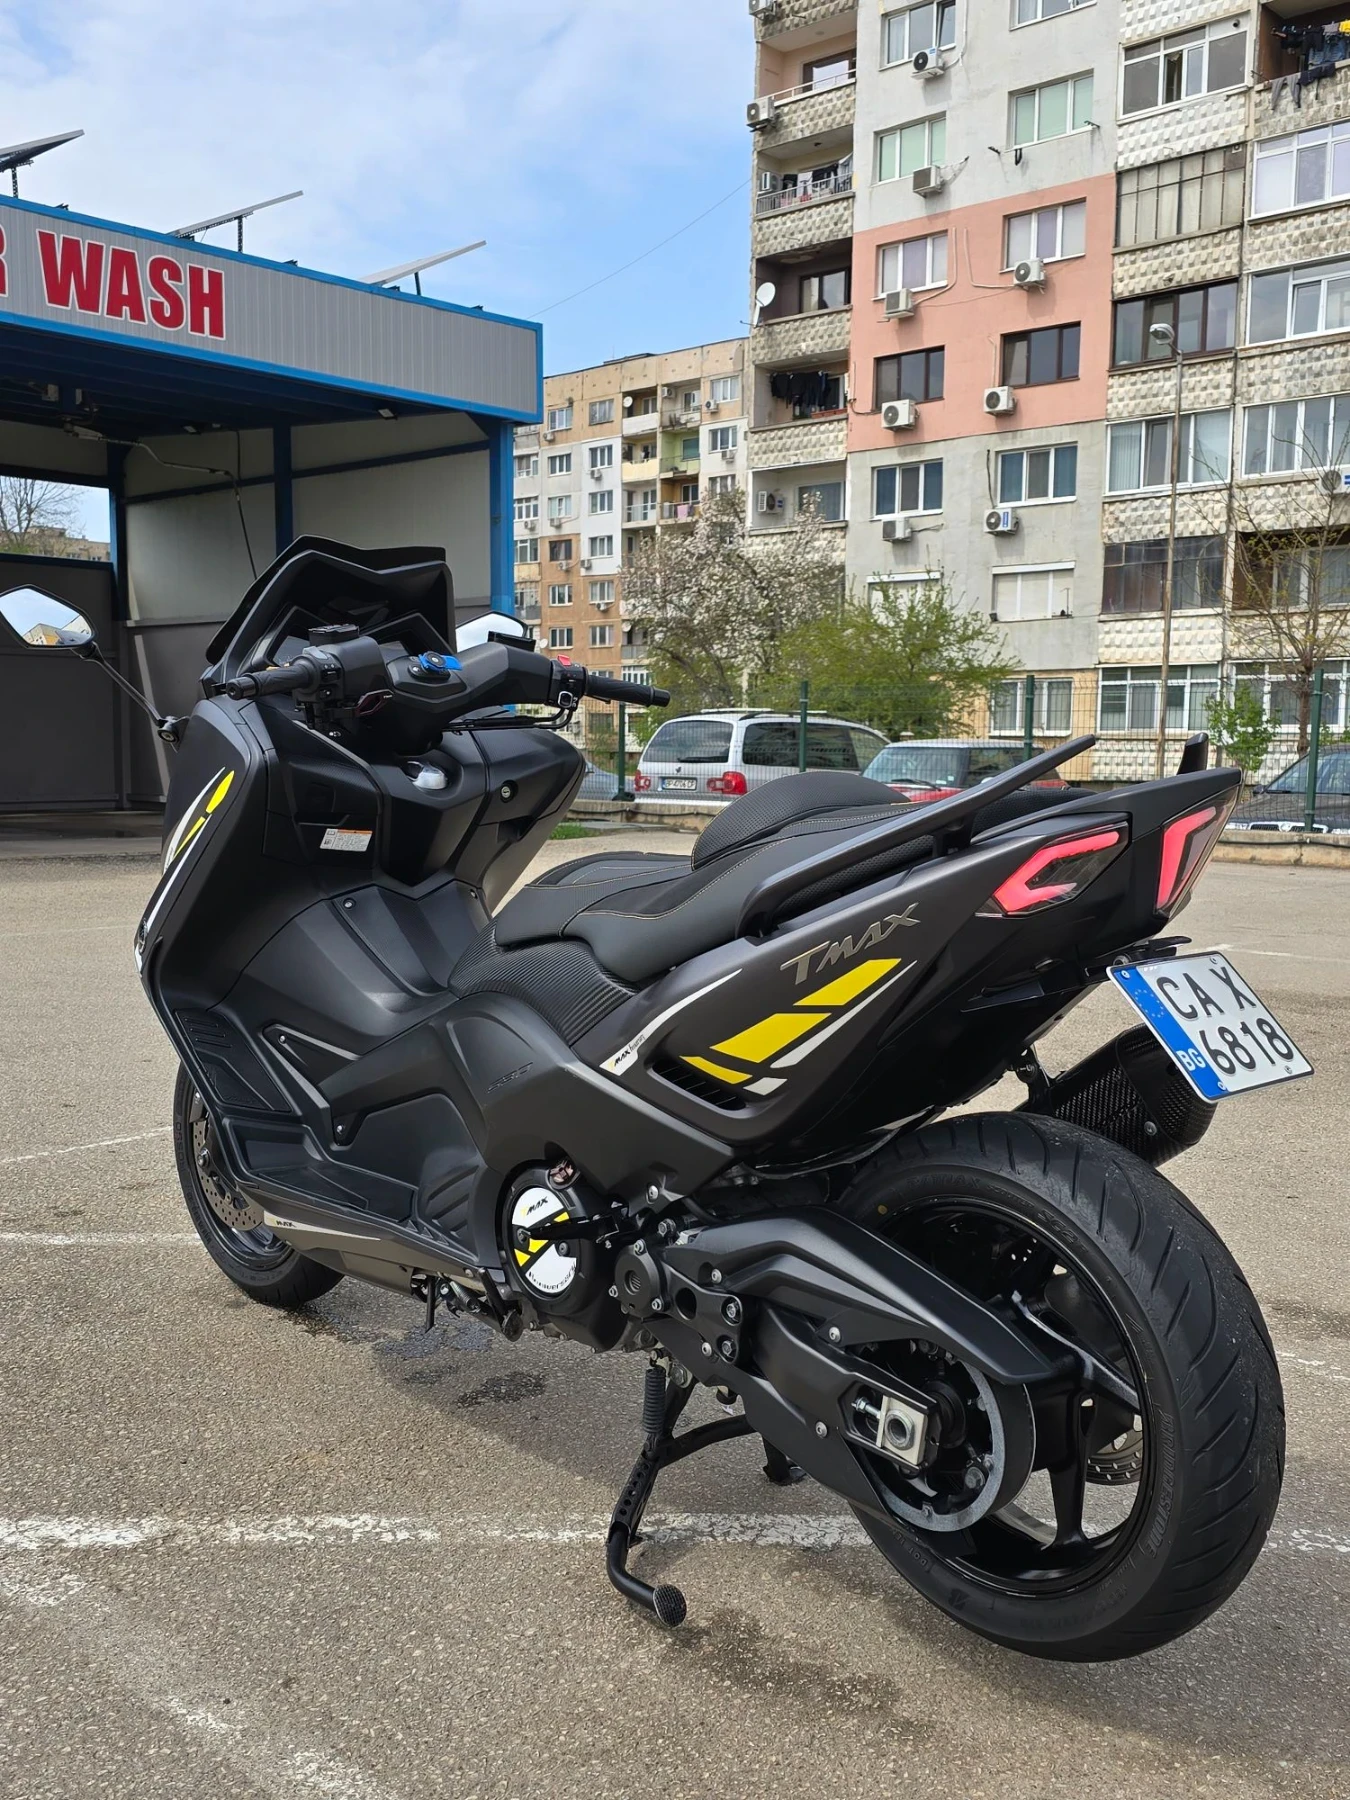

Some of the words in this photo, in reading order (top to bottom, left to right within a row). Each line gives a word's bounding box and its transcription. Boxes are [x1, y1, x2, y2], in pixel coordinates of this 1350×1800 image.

[36, 228, 226, 341] WASH
[780, 902, 921, 985] TMAX
[1156, 972, 1225, 1021] CA
[1209, 966, 1257, 1011] X
[1176, 1048, 1206, 1071] BG
[1199, 1018, 1294, 1076] 6818
[520, 1196, 549, 1218] TMAX
